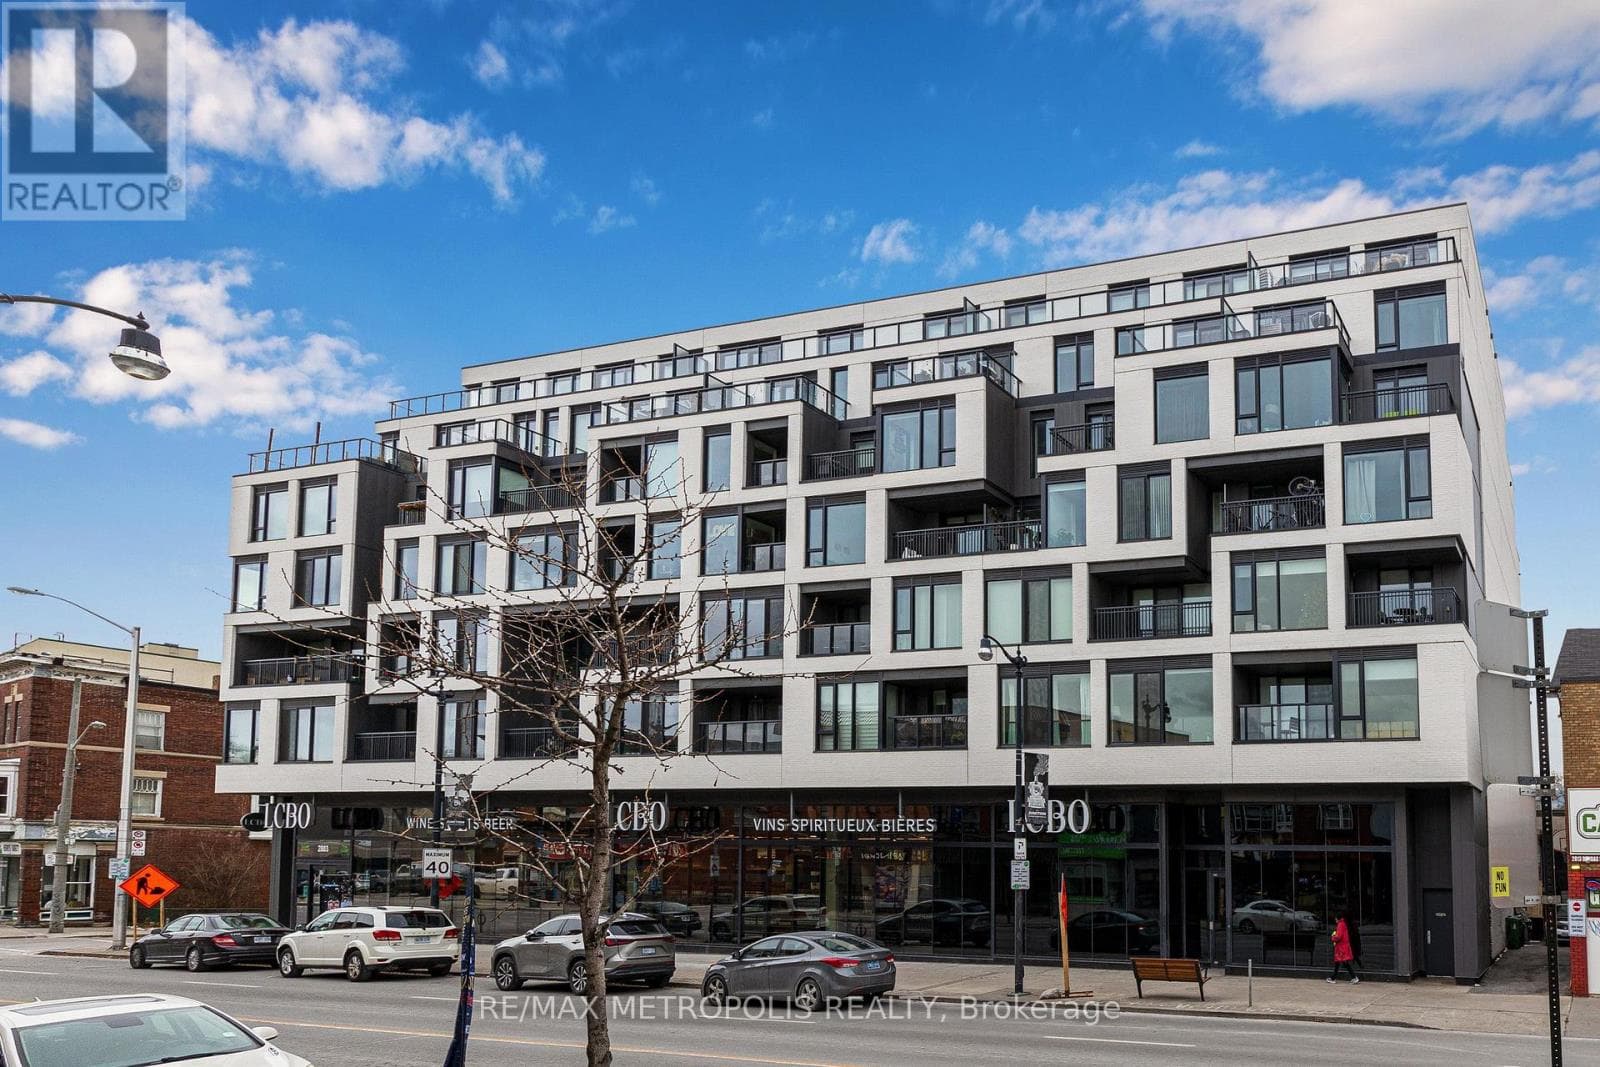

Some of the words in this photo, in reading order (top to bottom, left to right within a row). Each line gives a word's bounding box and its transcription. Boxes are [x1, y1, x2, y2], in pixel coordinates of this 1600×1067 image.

[262, 802, 311, 829] LCBO
[753, 818, 785, 831] VINS
[791, 818, 877, 832] SPIRITUEUX
[881, 816, 935, 832] BIÈRES
[425, 861, 449, 874] 40
[1496, 870, 1505, 880] NO
[1494, 882, 1507, 893] FUN
